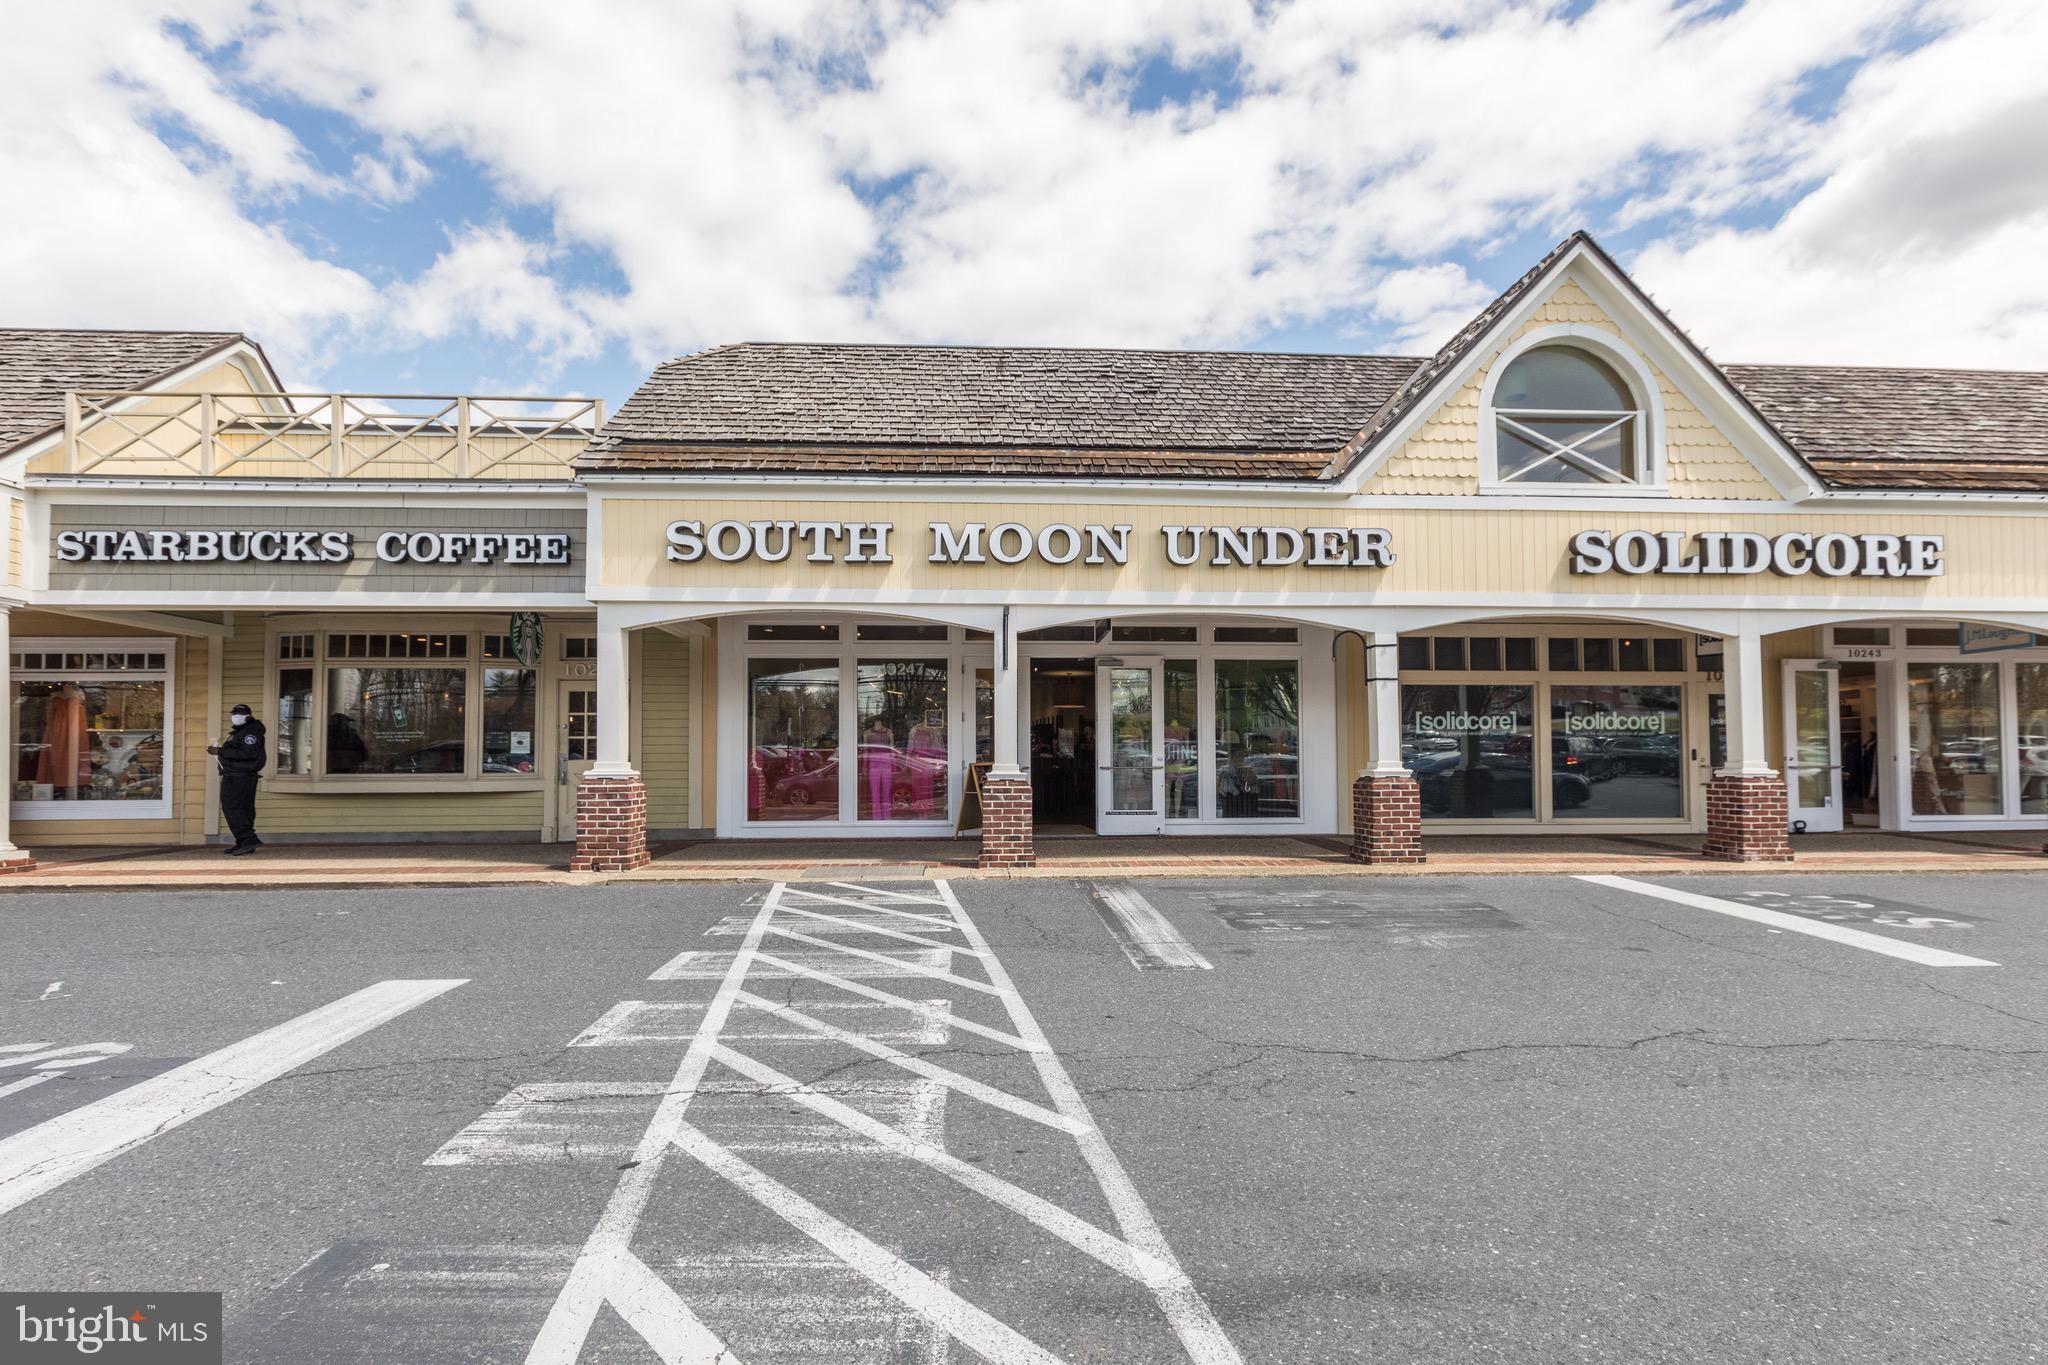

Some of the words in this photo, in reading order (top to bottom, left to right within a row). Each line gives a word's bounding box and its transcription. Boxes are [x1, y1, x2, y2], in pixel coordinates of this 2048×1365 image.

[56, 529, 353, 564] STARBUCKS
[376, 532, 571, 565] COFFEE
[666, 519, 894, 564] SOUTH
[928, 522, 1132, 565] MOON
[1161, 524, 1397, 569] UNDER
[1569, 529, 1945, 577] SOLIDCORE
[1848, 649, 1882, 658] 10243
[563, 662, 598, 677] 102
[879, 662, 925, 677] 10247
[1416, 711, 1517, 734] [solidcore]
[1565, 711, 1666, 734] [solidcore]
[1166, 743, 1198, 760] HINE
